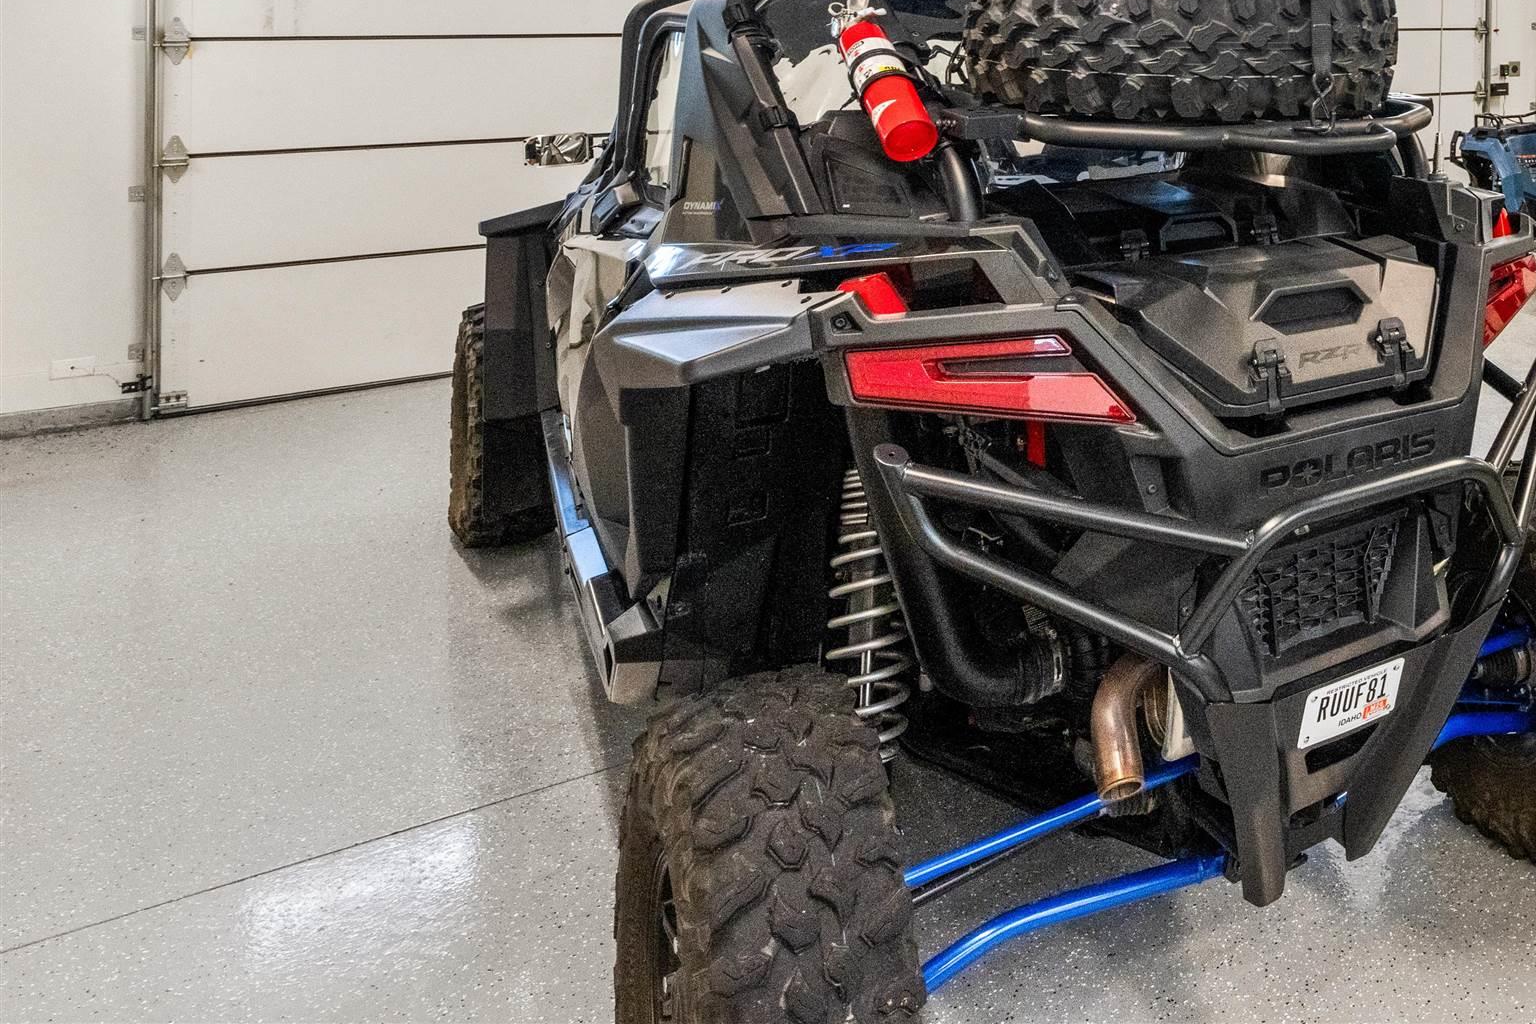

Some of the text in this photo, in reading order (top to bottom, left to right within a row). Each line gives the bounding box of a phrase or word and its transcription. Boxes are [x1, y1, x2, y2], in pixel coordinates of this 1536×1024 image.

[1299, 343, 1364, 369] RZR
[1258, 428, 1436, 500] POLARIS
[1316, 673, 1388, 723] RUUF81
[1326, 676, 1364, 695] RESTRICTED
[1337, 712, 1363, 727] IDAHO
